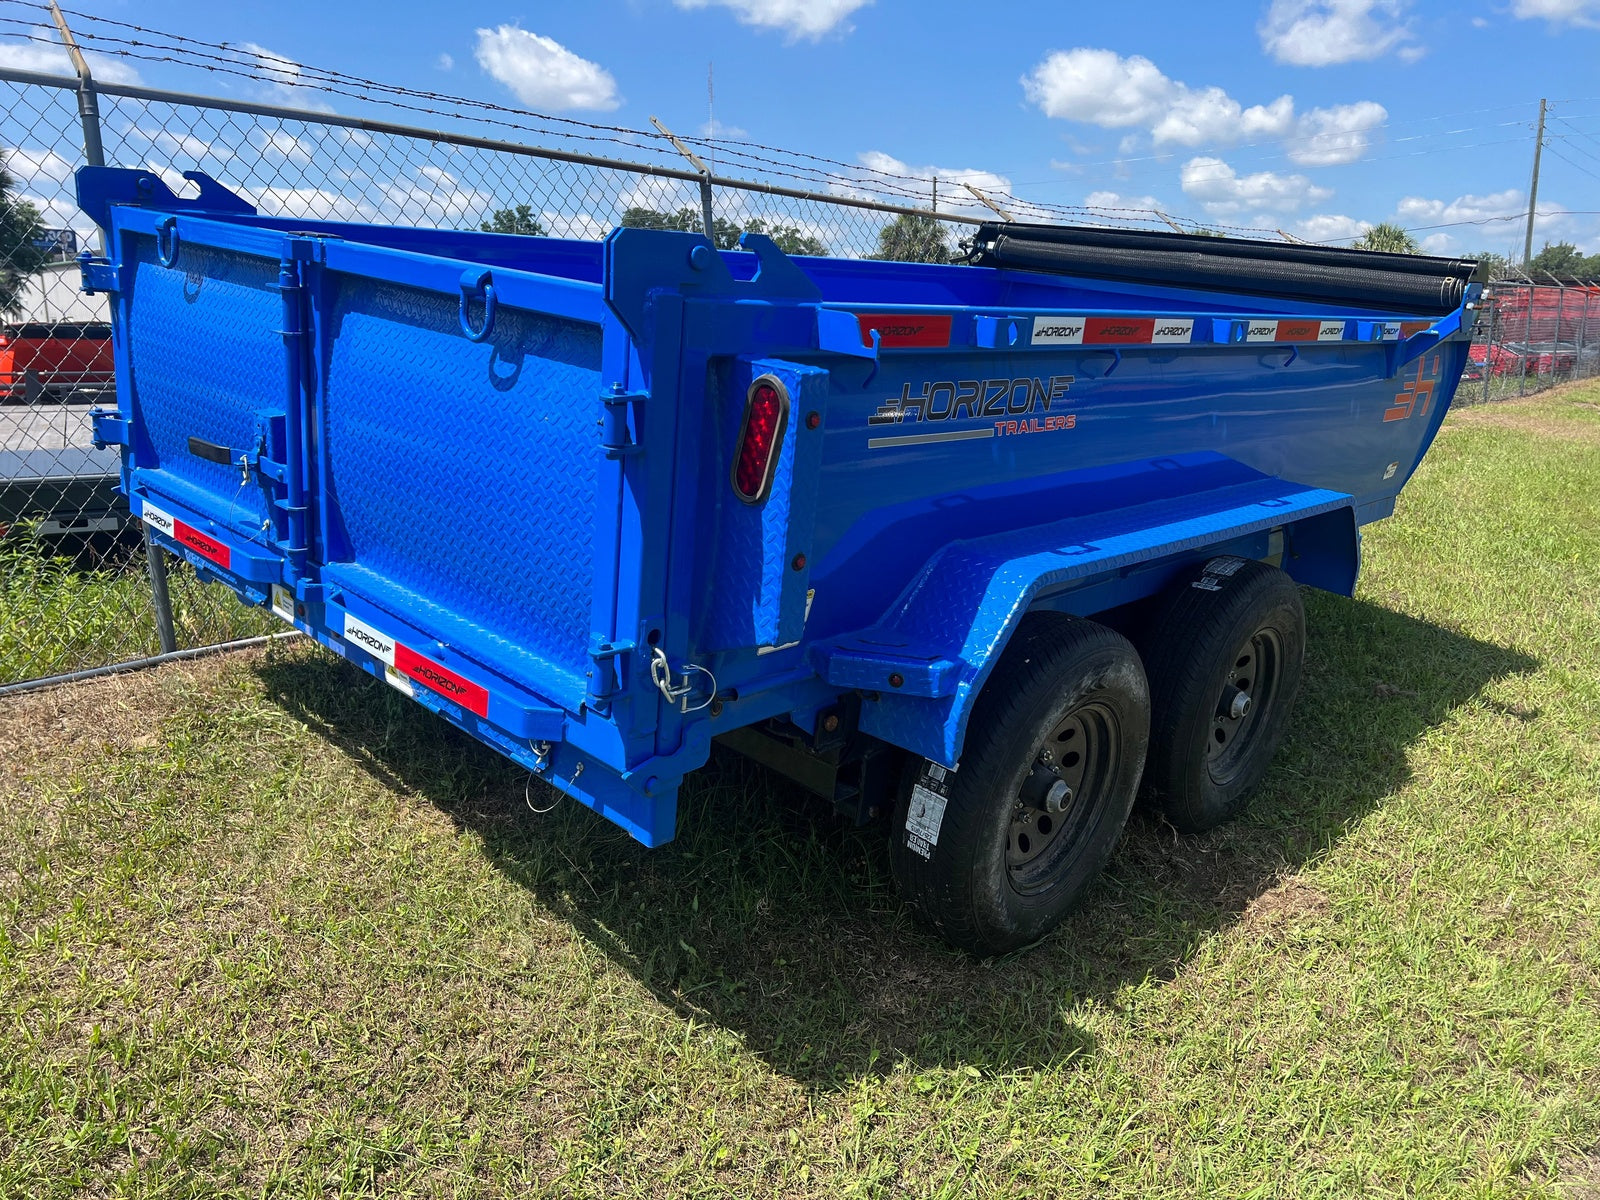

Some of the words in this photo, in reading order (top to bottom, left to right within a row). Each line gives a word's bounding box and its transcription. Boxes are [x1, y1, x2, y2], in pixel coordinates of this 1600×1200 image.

[1037, 327, 1079, 338] HORIZON
[1103, 327, 1138, 337] HORIZON
[1157, 327, 1189, 337] HORIZON
[1249, 328, 1273, 337] HORIZON
[1321, 328, 1340, 336] HORIZON
[890, 376, 1060, 423] HORIZON
[994, 415, 1077, 437] TRAILERS
[146, 509, 170, 528] HORIZON
[187, 535, 215, 555] HORIZON
[350, 626, 389, 654] HORIZON
[416, 665, 465, 697] HORIZON
